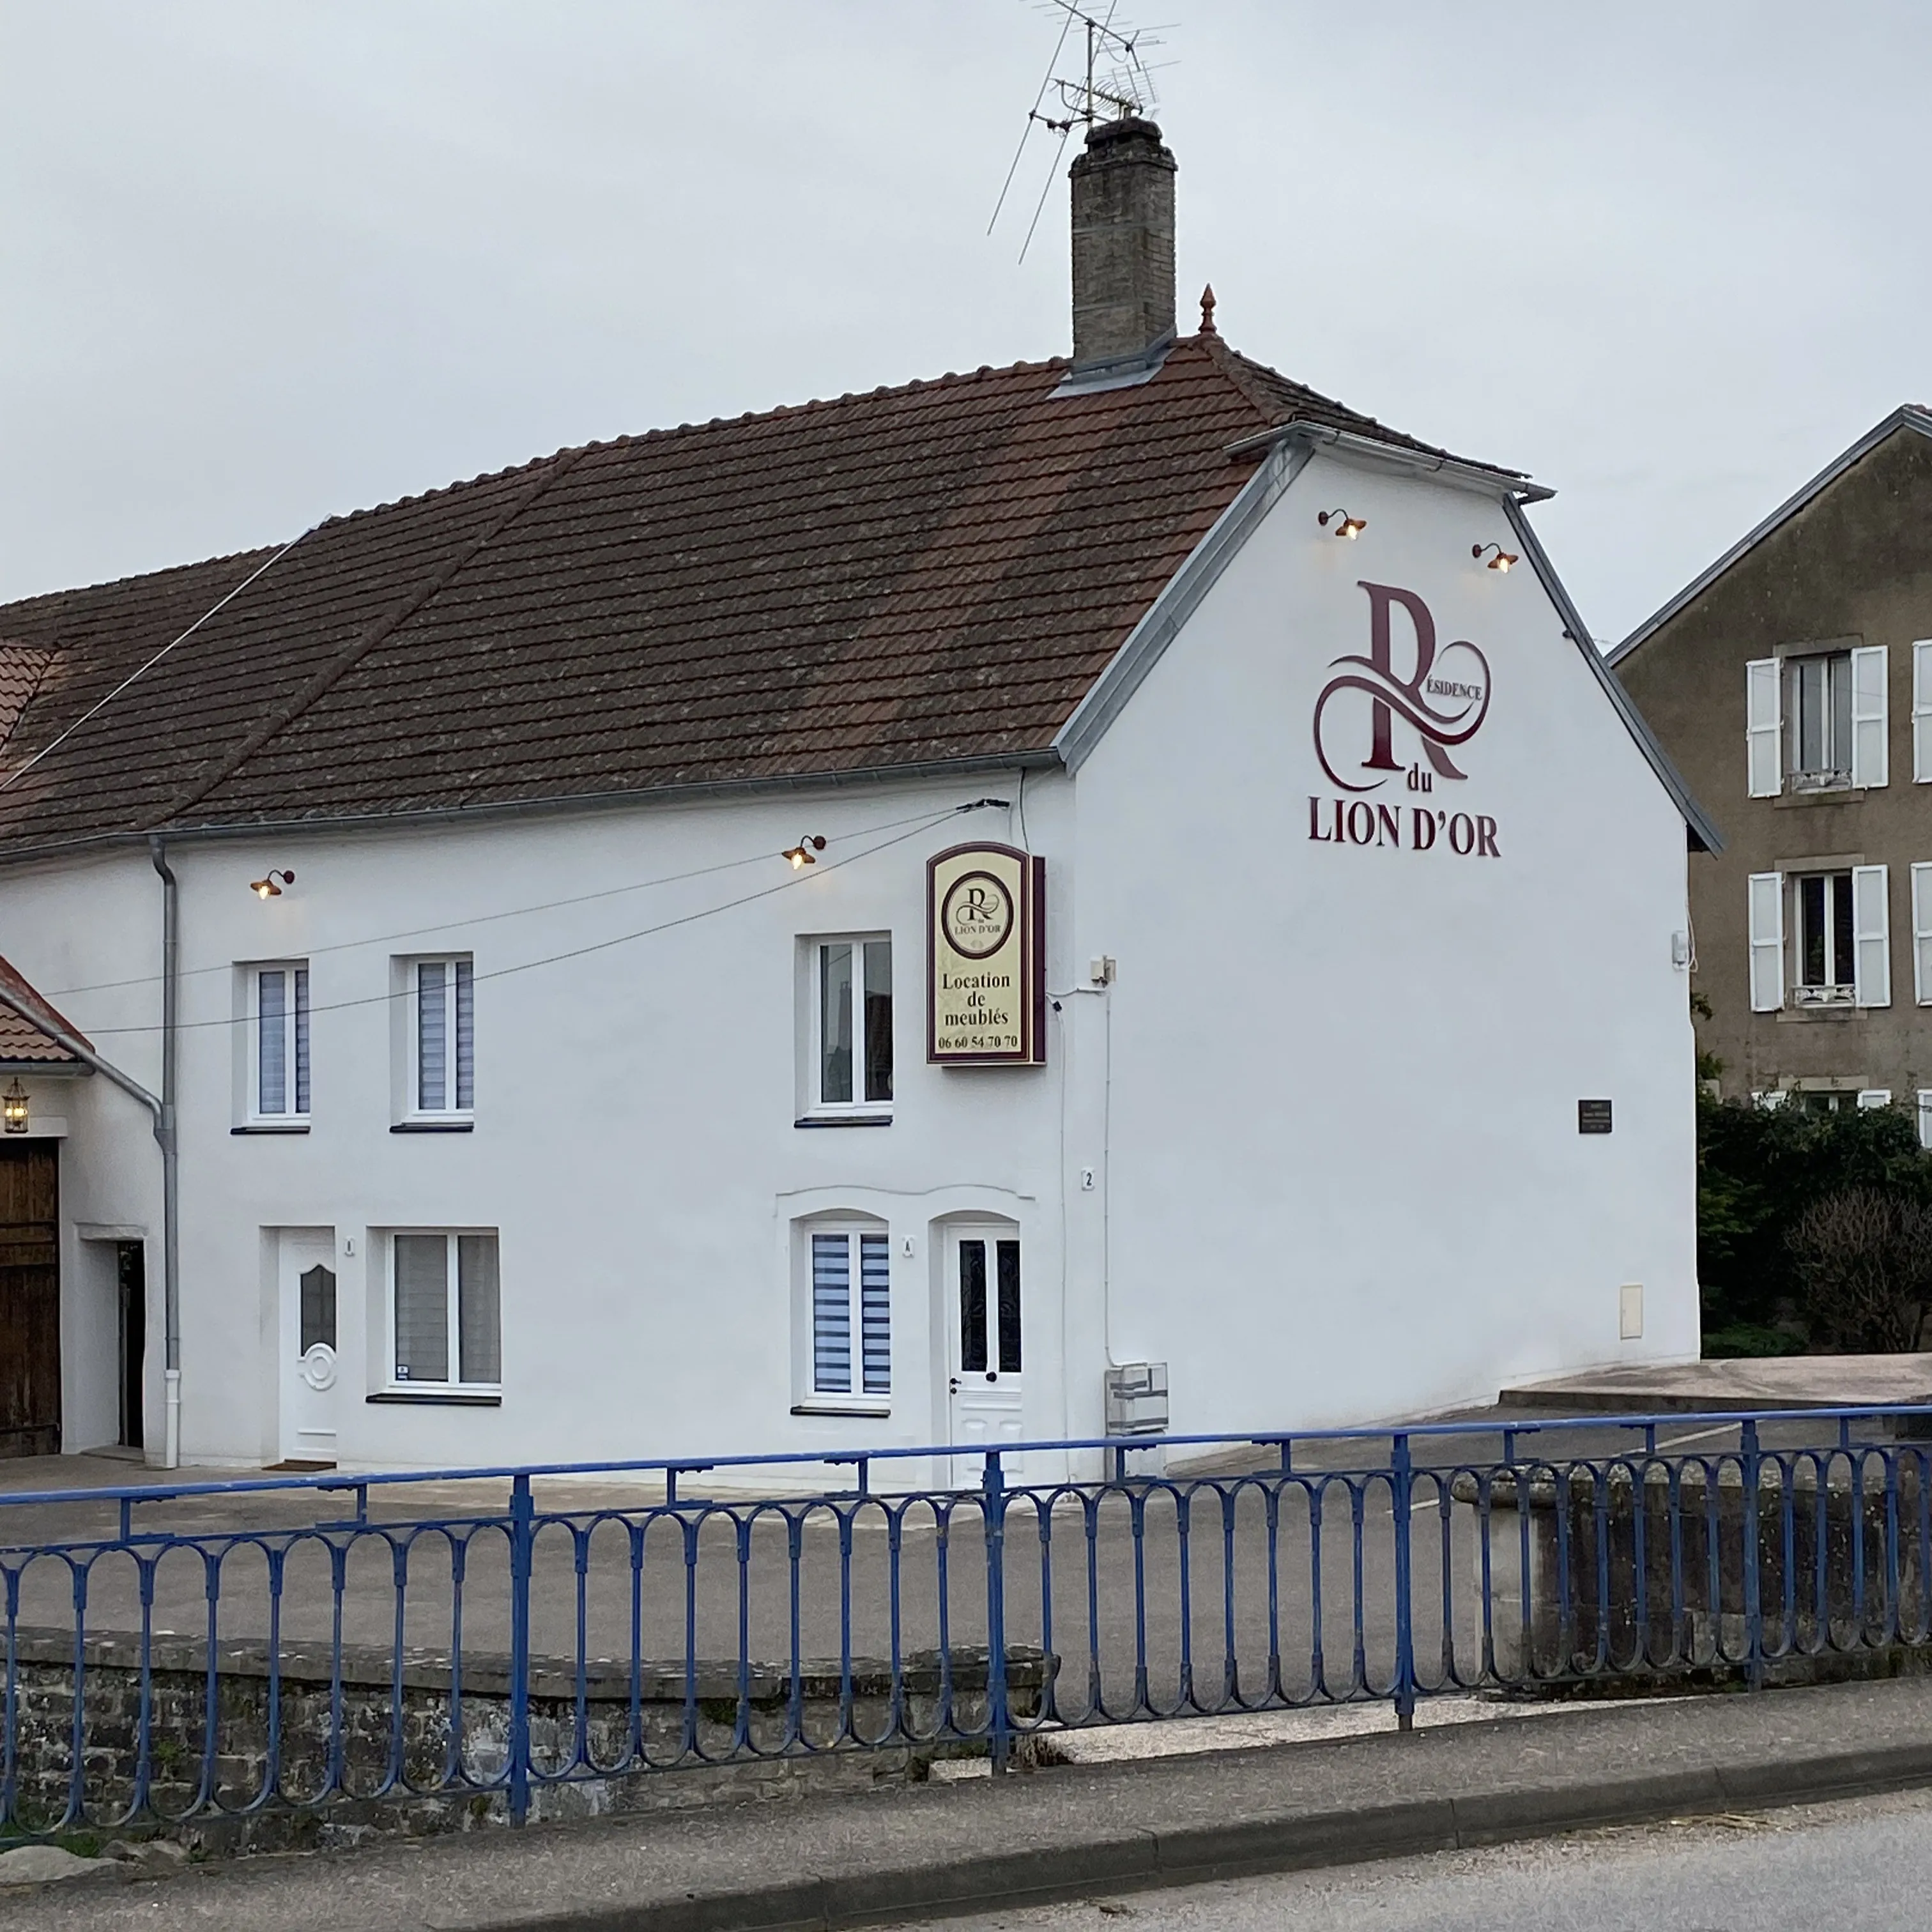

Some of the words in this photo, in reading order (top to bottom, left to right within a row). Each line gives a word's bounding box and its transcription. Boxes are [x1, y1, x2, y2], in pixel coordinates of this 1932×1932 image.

[1407, 762, 1432, 792] du
[1308, 797, 1401, 847] LION
[1412, 808, 1501, 857] D'OR
[955, 926, 976, 935] LION
[979, 925, 1000, 933] D'OR
[943, 972, 1010, 990] Location
[967, 991, 986, 1007] de
[945, 1008, 1009, 1026] meublés
[939, 1037, 952, 1048] 06
[954, 1036, 968, 1048] 60
[972, 1036, 984, 1048] 54
[987, 1036, 1001, 1048] 70
[1004, 1035, 1018, 1047] 70
[1086, 1172, 1092, 1186] 2
